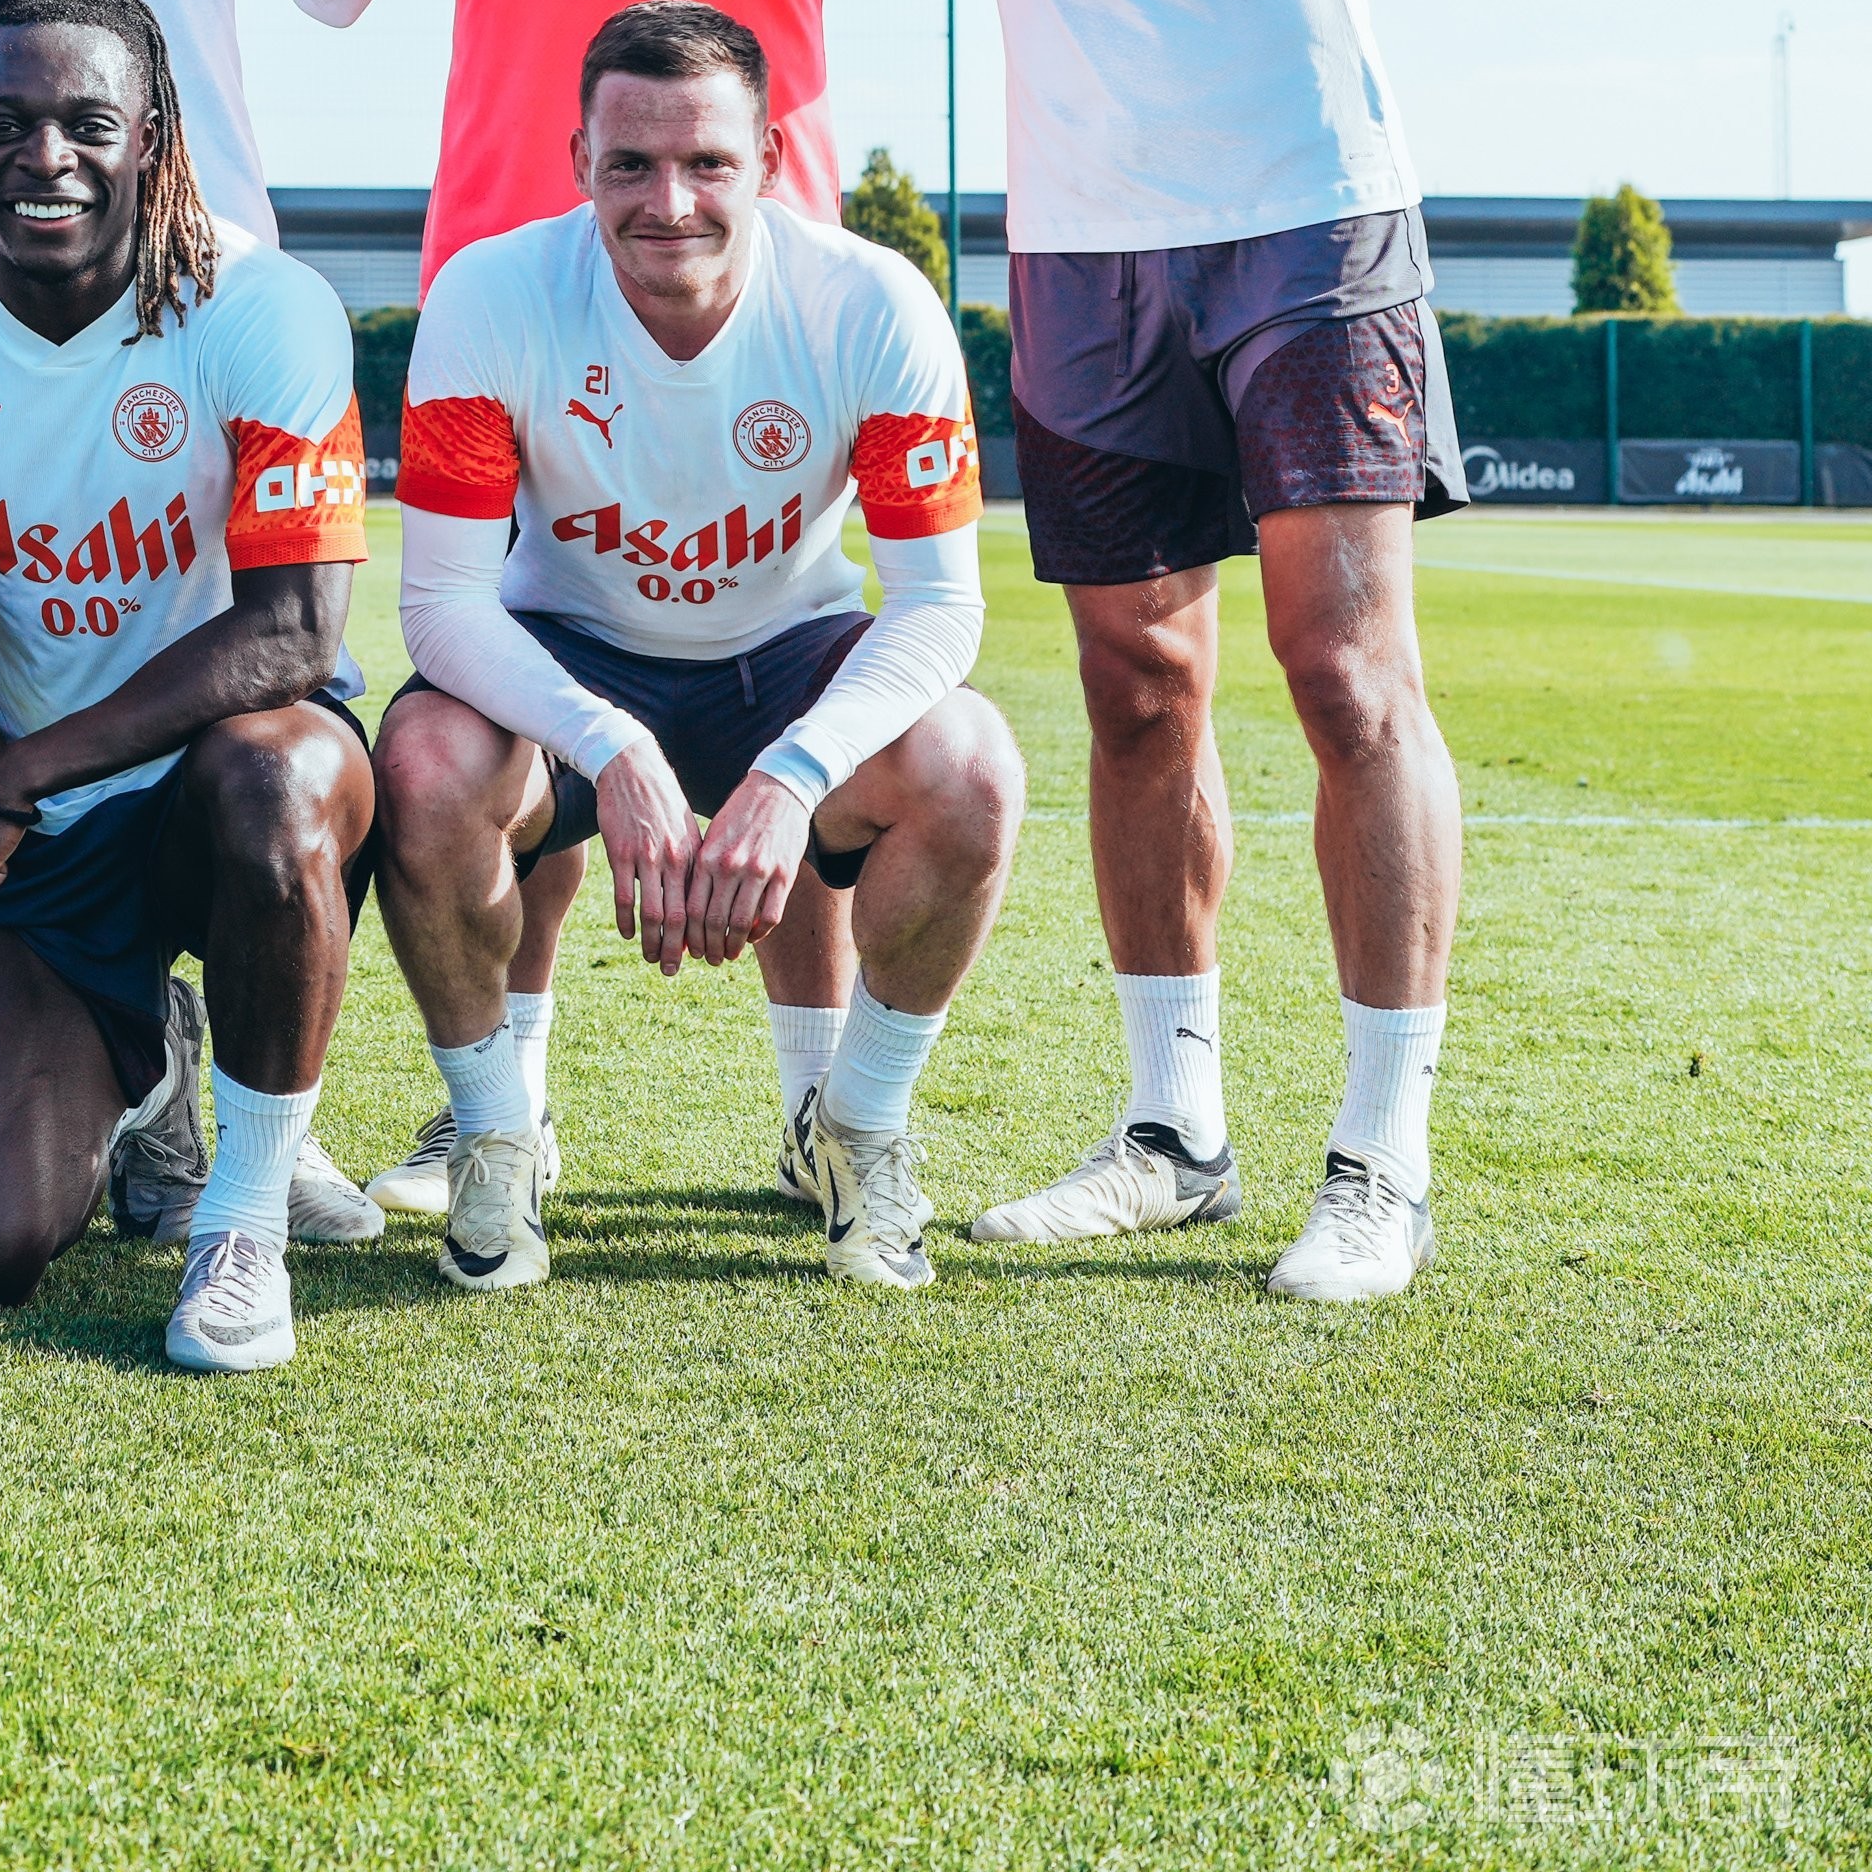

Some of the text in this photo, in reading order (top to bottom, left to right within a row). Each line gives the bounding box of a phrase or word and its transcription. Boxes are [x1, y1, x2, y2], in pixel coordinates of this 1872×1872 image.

[586, 364, 610, 395] 21
[1385, 363, 1401, 394] 3
[120, 389, 180, 414] MANCHESTER
[741, 405, 802, 430] MANCHESTER
[141, 448, 164, 457] CITY
[763, 459, 786, 468] CITY
[1475, 458, 1576, 492] Midea
[552, 492, 803, 573] Asahi
[637, 574, 739, 606] 0.0%
[41, 595, 142, 638] 0.0%
